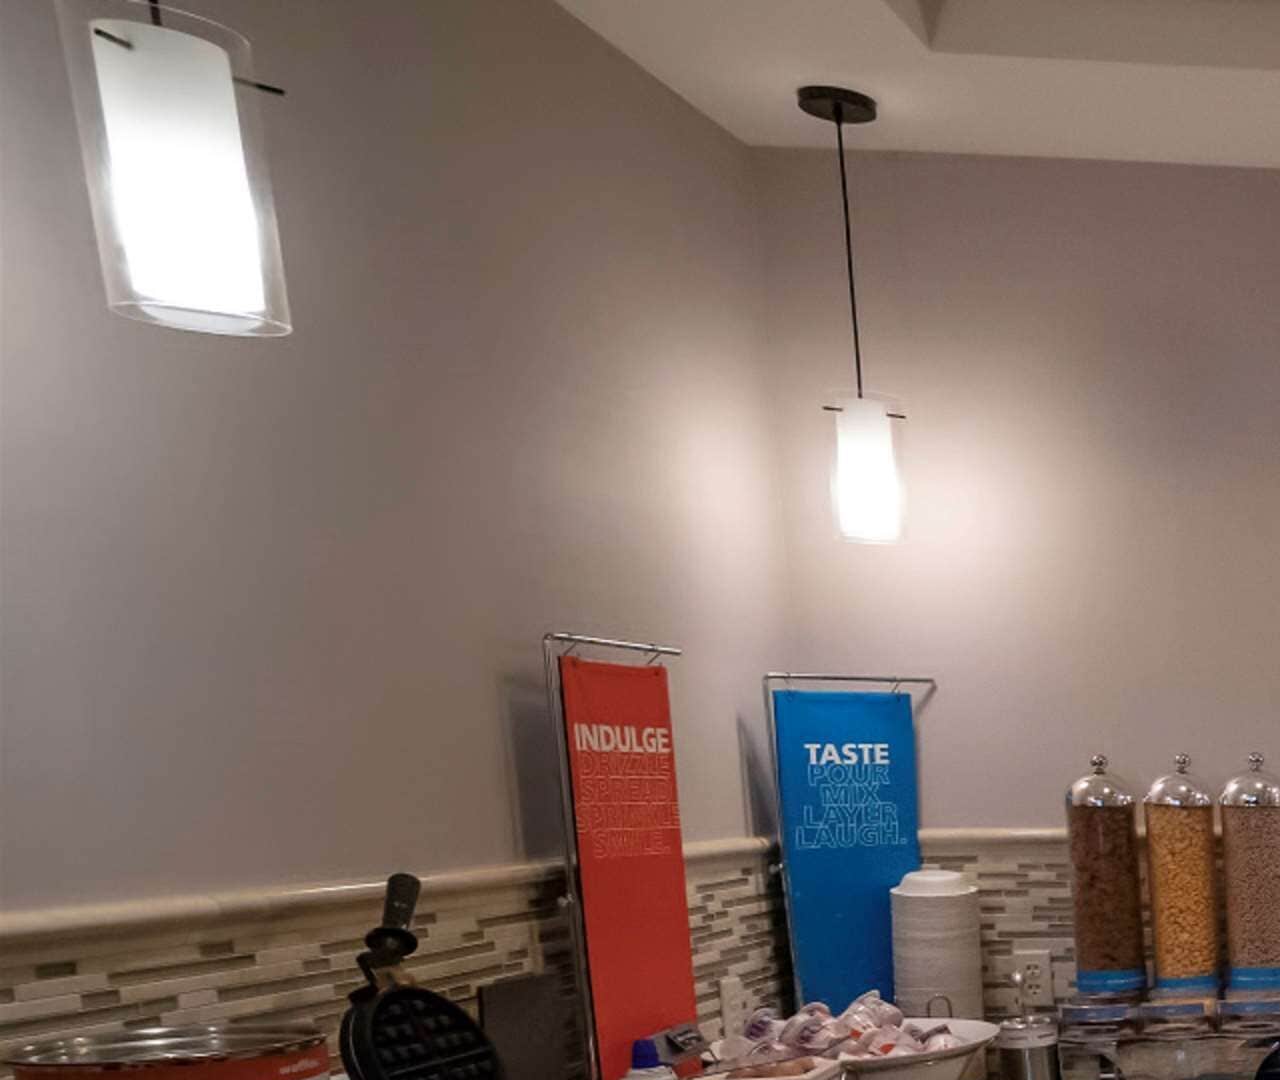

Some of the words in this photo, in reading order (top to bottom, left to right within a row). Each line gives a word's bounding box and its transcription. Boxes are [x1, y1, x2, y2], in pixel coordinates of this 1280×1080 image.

[574, 723, 671, 753] INDULGE
[803, 743, 891, 765] TASTE
[807, 763, 891, 786] POUR
[579, 776, 676, 804] SPREAD
[820, 783, 880, 807] MIX
[803, 801, 898, 829] LAYER
[795, 822, 908, 849] LAUGH.
